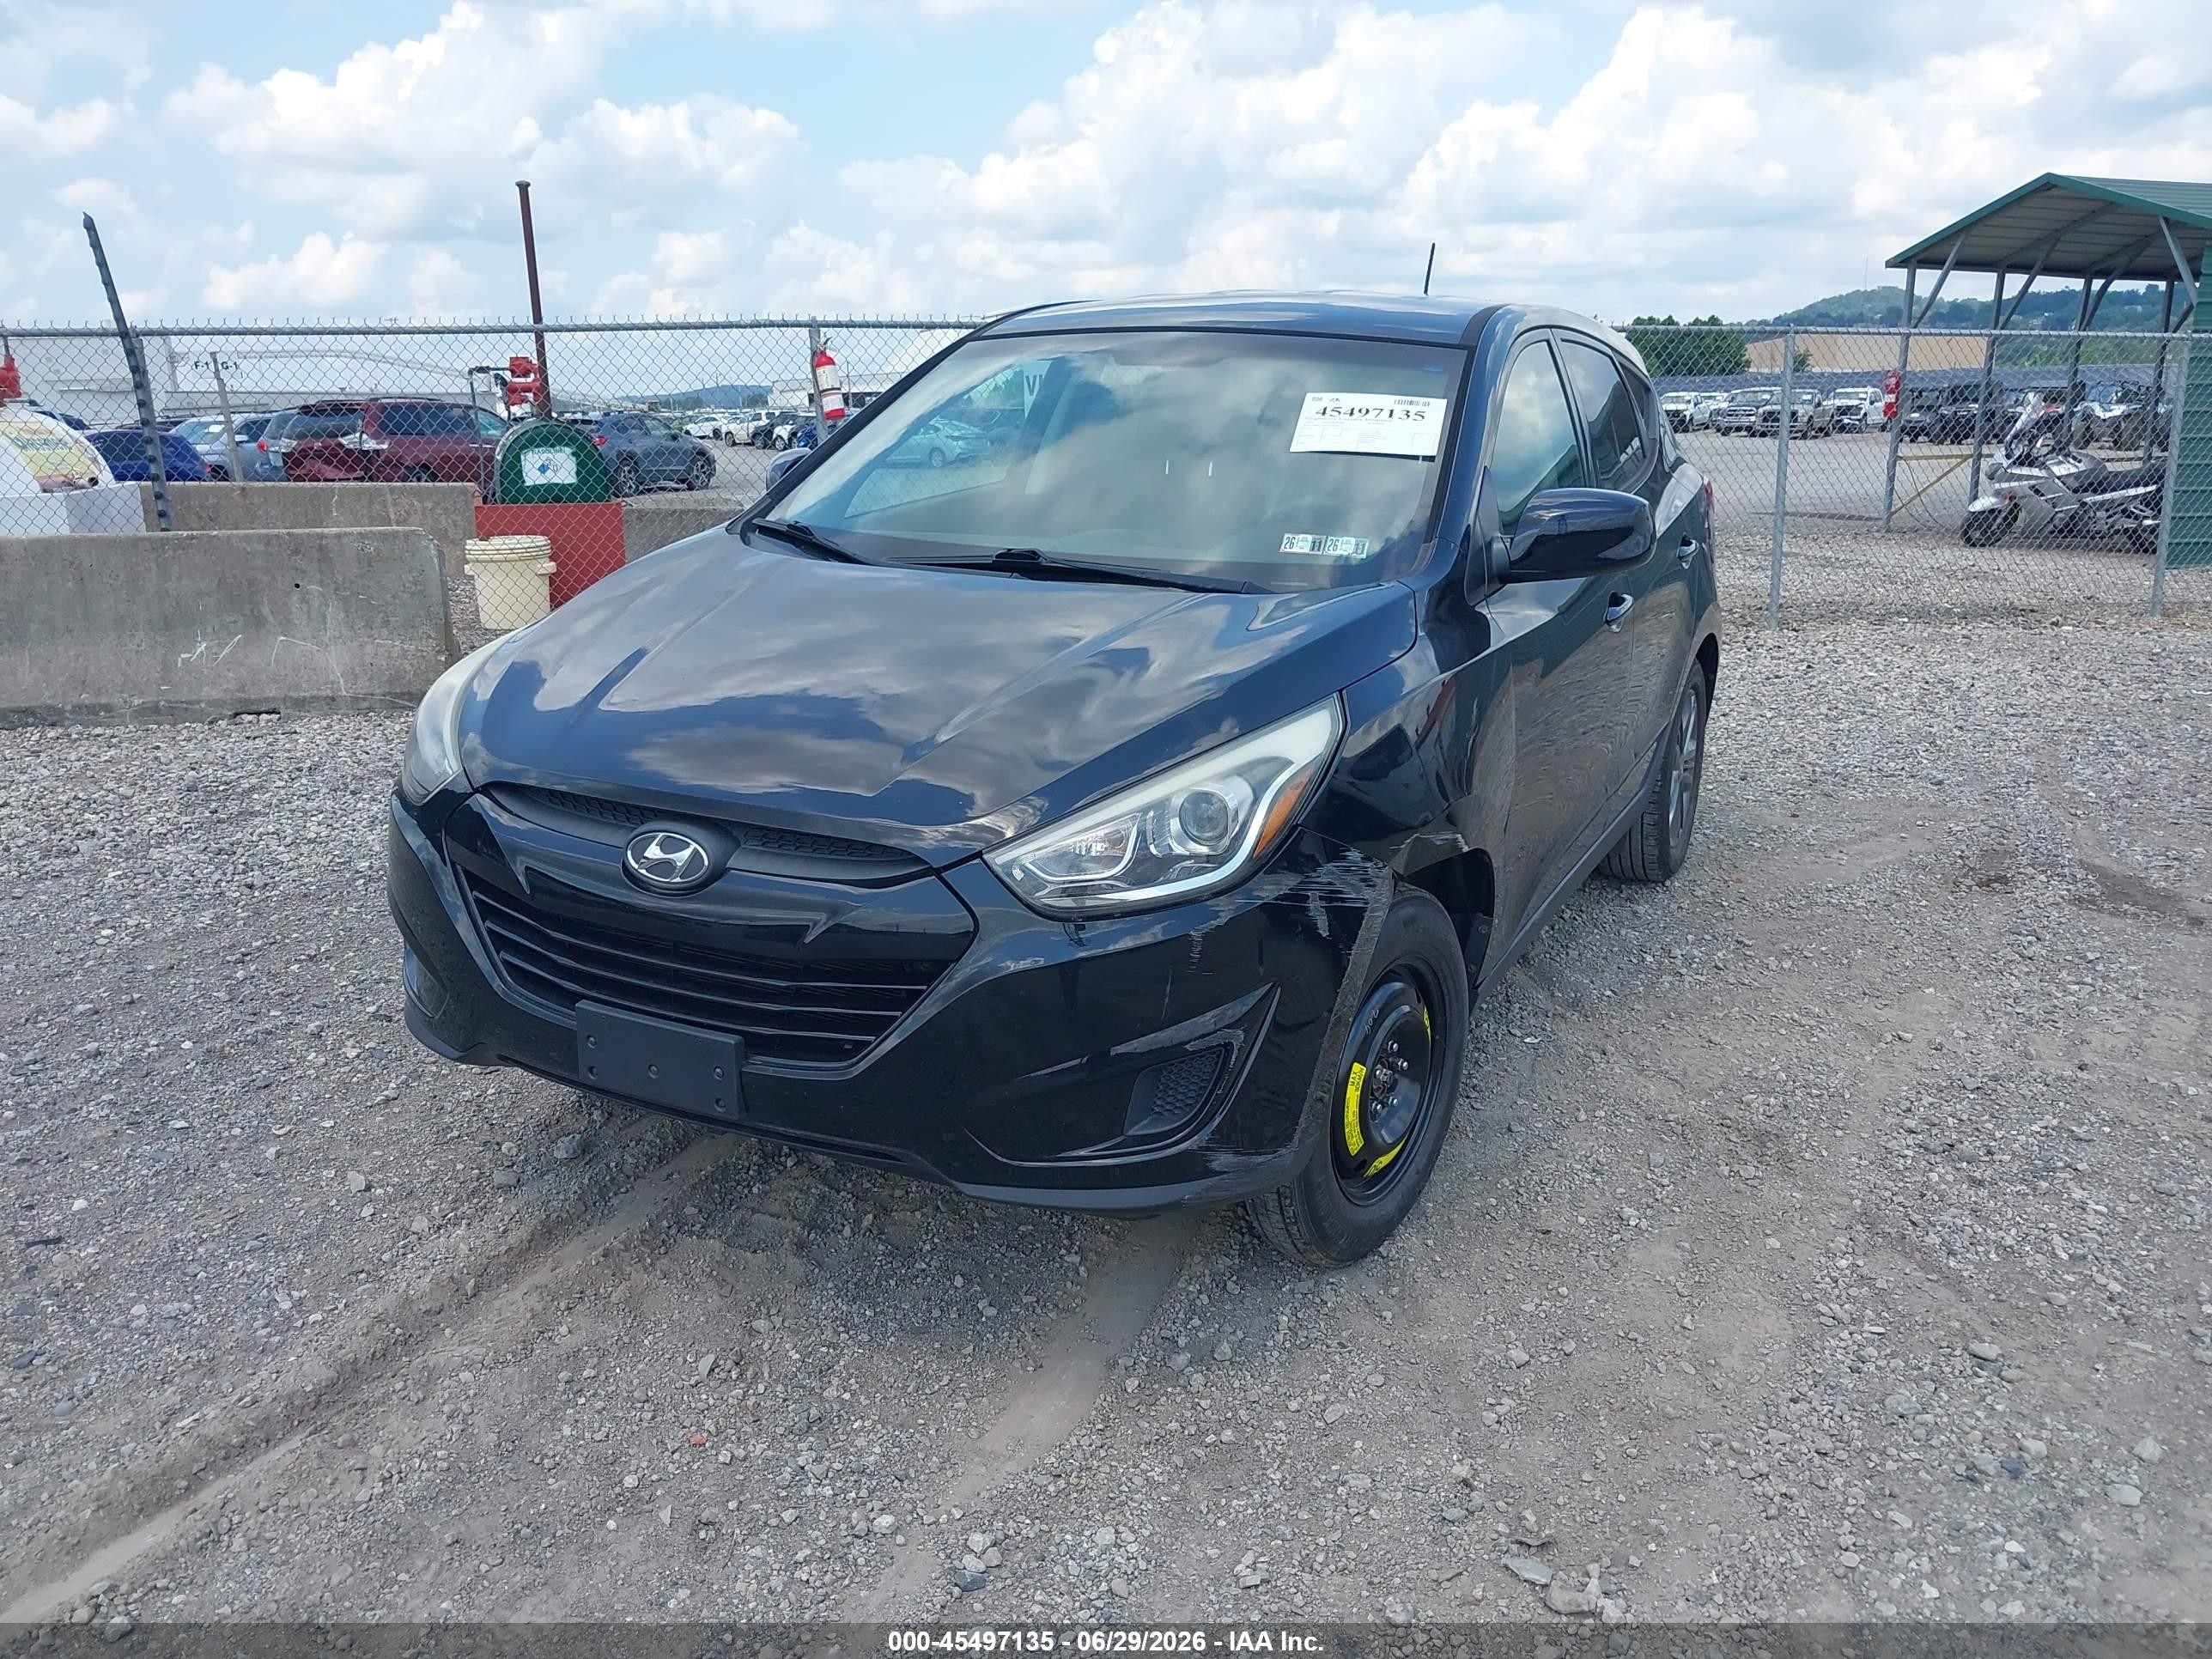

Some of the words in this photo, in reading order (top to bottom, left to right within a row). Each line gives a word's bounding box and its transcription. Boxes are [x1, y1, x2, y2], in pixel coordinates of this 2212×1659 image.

[194, 361, 210, 370] F-1
[221, 361, 238, 370] G-1
[1315, 405, 1426, 422] 45497135
[1284, 536, 1296, 550] 26
[1328, 538, 1340, 551] 26
[1349, 1071, 1358, 1087] MAX
